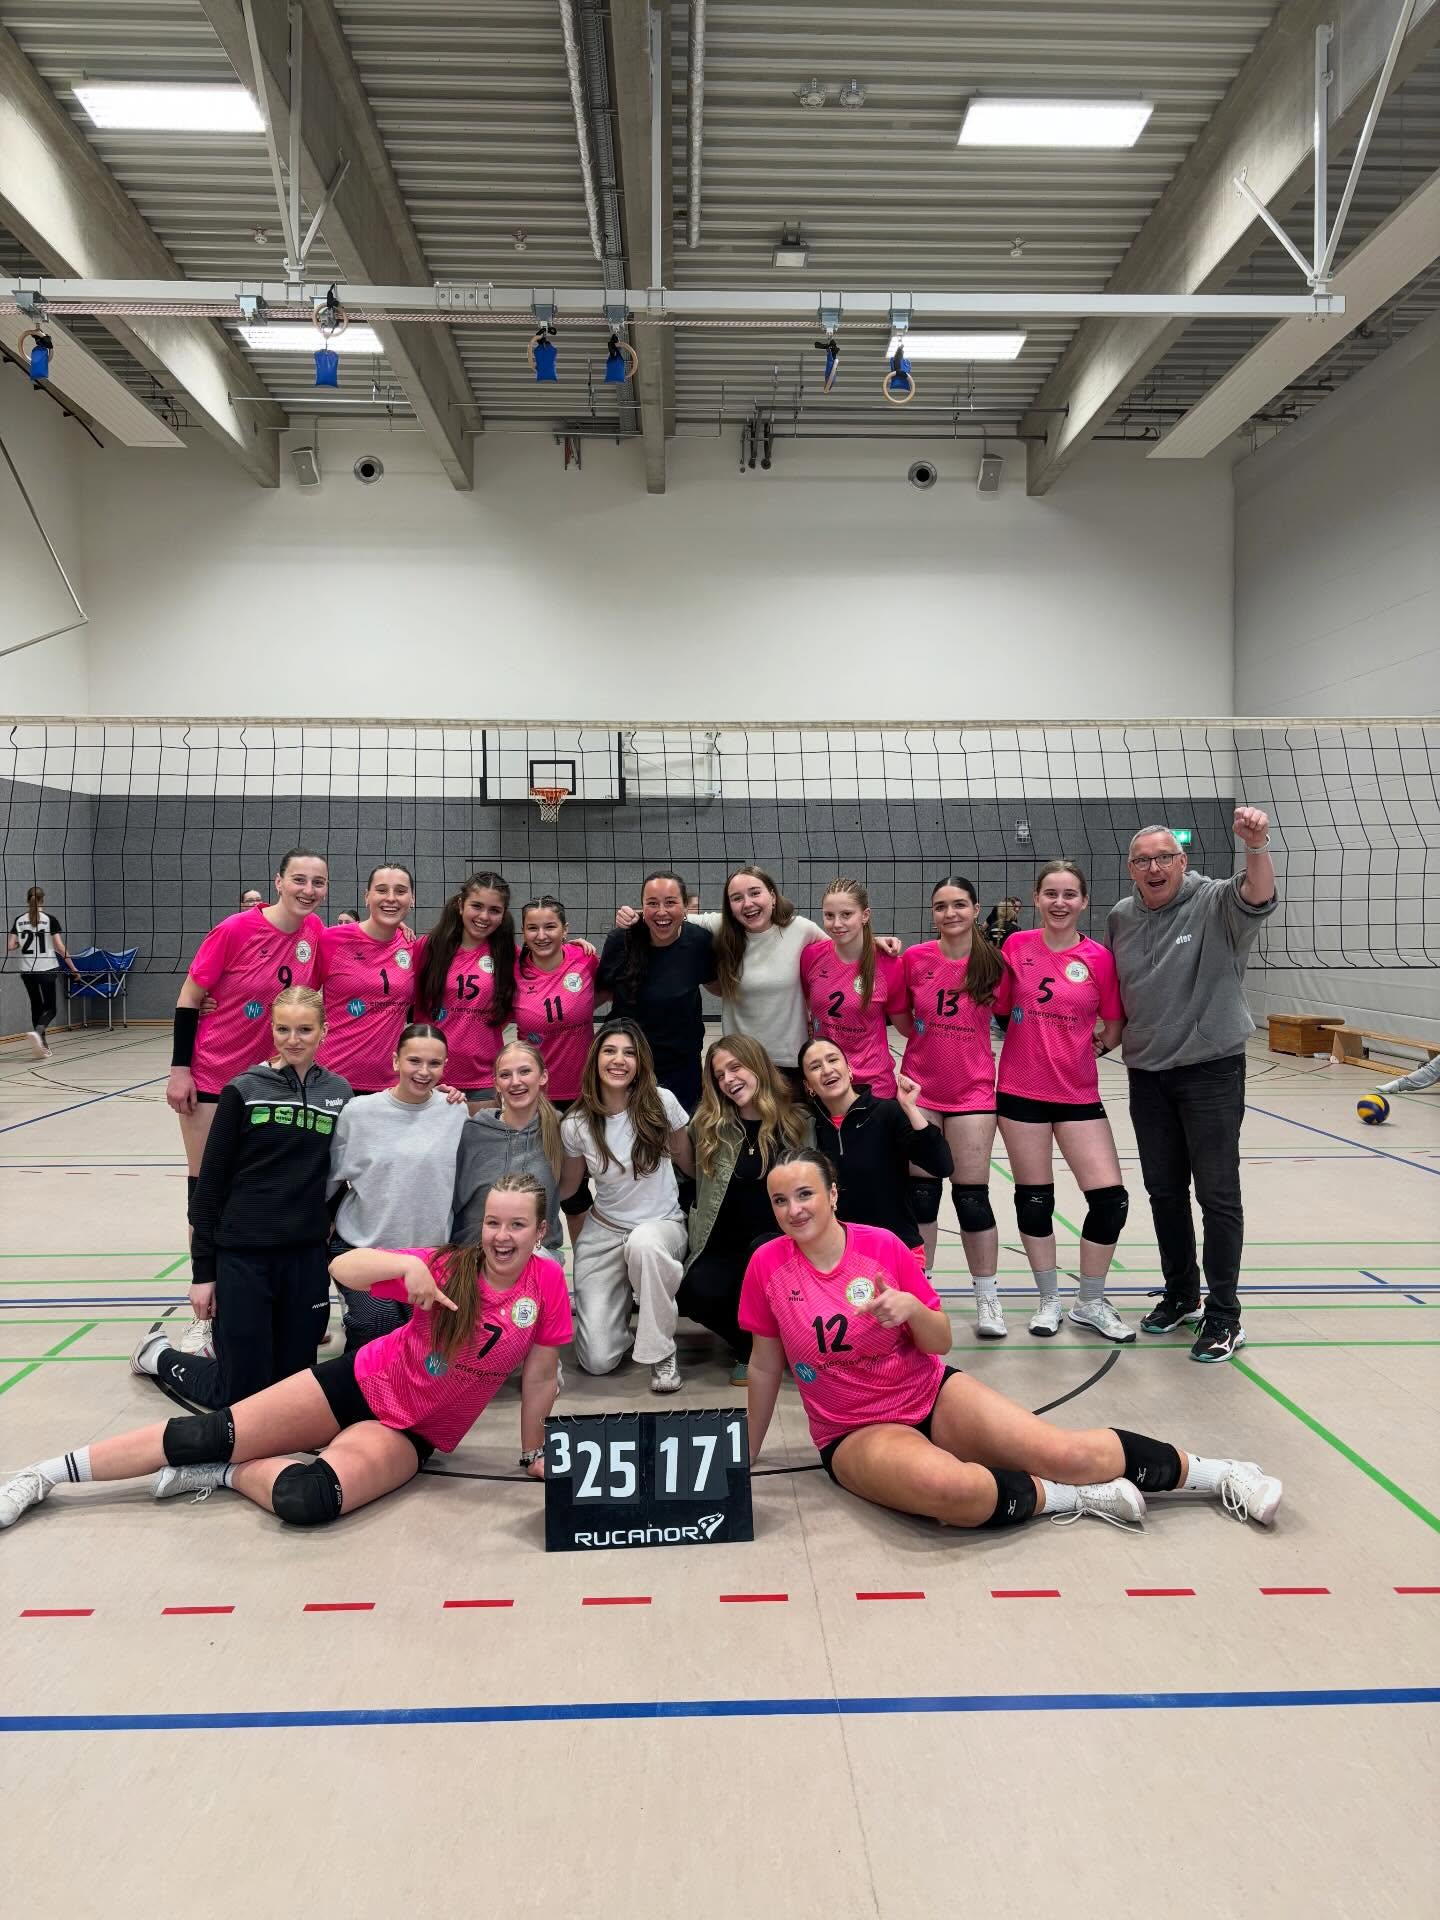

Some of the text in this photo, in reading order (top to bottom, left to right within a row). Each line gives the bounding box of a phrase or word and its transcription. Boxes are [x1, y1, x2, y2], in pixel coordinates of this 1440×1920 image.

[21, 929, 47, 954] 21
[277, 965, 293, 989] 9
[379, 968, 390, 994] 1
[456, 973, 480, 1000] 15
[1036, 977, 1055, 1003] 5
[543, 995, 564, 1023] 11
[827, 991, 846, 1018] 2
[935, 988, 960, 1017] 13
[476, 1323, 503, 1360] 7
[812, 1314, 853, 1354] 12
[550, 1422, 741, 1498] 3 25 17 1
[575, 1523, 701, 1546] RUCANOR
